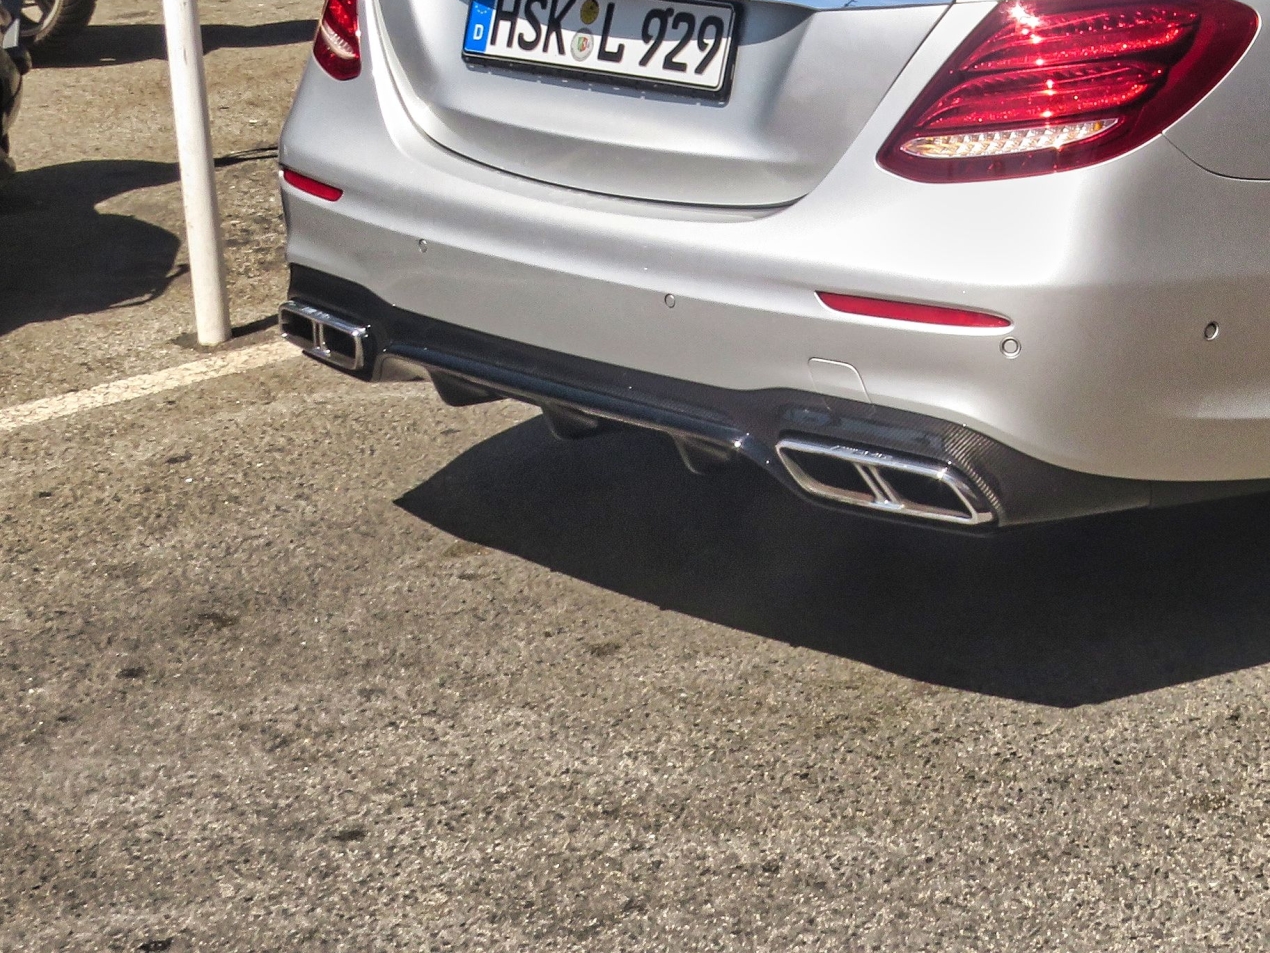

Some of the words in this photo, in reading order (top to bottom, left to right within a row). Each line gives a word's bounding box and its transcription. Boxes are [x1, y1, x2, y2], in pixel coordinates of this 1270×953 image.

[473, 24, 485, 41] D
[597, 2, 625, 63] L
[638, 6, 725, 75] 929
